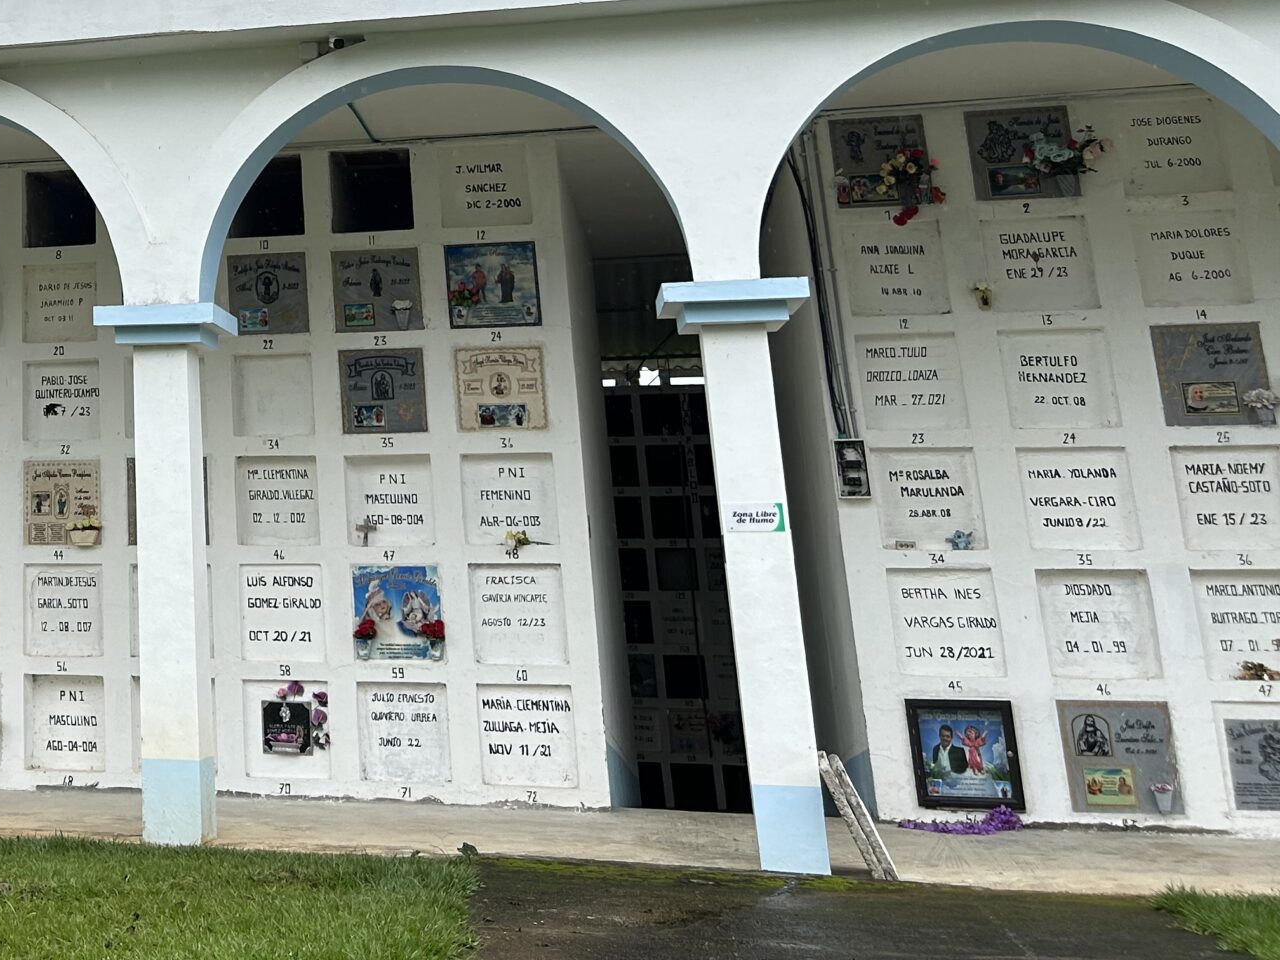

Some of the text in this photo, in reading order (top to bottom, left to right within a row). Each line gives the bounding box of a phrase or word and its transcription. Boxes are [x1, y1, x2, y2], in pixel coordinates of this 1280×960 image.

[1130, 115, 1201, 127] JOSE DIOGENES
[1147, 136, 1192, 146] DURANGO
[466, 163, 502, 173] WILMAR
[1145, 160, 1162, 169] JUL
[465, 183, 507, 193] SANCHEZ
[466, 200, 481, 209] DIC
[1181, 196, 1189, 206] 3
[1023, 203, 1030, 213] 2
[476, 230, 485, 240] 12
[999, 231, 1065, 244] GUADALUPE
[1151, 227, 1231, 241] MARIA DOLORES
[369, 235, 375, 245] 11
[861, 245, 880, 255] ANA
[1171, 250, 1205, 260] DUQUE
[1006, 268, 1027, 279] ENE
[1169, 272, 1182, 281] AG
[1196, 310, 1207, 320] 14
[900, 319, 909, 329] 12
[374, 335, 387, 346] 23
[491, 331, 502, 342] 24
[263, 340, 274, 349] 22
[53, 346, 65, 355] 20
[1020, 355, 1078, 367] BERTULFO
[1018, 371, 1088, 383] HERNANDEZ
[381, 437, 394, 447] 35
[912, 433, 924, 444] 23
[1217, 431, 1230, 443] 25
[906, 469, 949, 481] ROSALBA
[1068, 468, 1117, 479] YOLANDA
[480, 490, 531, 500] FEMENINO
[900, 486, 964, 498] MARULANDA
[1197, 513, 1218, 525] ENE
[273, 550, 284, 560] 46
[383, 551, 395, 561] 47
[1077, 554, 1092, 565] 35
[247, 575, 314, 587] LUIS ALFONSO
[485, 576, 536, 585] FRACISCA
[901, 588, 981, 599] BERTHA INES
[1064, 584, 1112, 595] DIOSDADO
[513, 594, 547, 603] HINCAPIE
[482, 618, 511, 627] AGOSTO
[904, 617, 996, 628] VARGAS GIRALDO
[1070, 611, 1100, 623] MEJIA
[249, 630, 270, 641] OCT
[905, 646, 933, 658] JUN
[392, 667, 405, 678] 59
[948, 681, 962, 690] 45
[371, 693, 434, 704] JULIO ERNESTO
[517, 697, 571, 712] CLEMENTINA
[49, 715, 97, 726] MASCULINO
[411, 713, 437, 722] URREA
[483, 721, 523, 732] ZULUAGA
[379, 737, 421, 747] JUNIO 22
[489, 744, 512, 755] NOV
[279, 783, 290, 794] 70
[527, 791, 537, 802] 72
